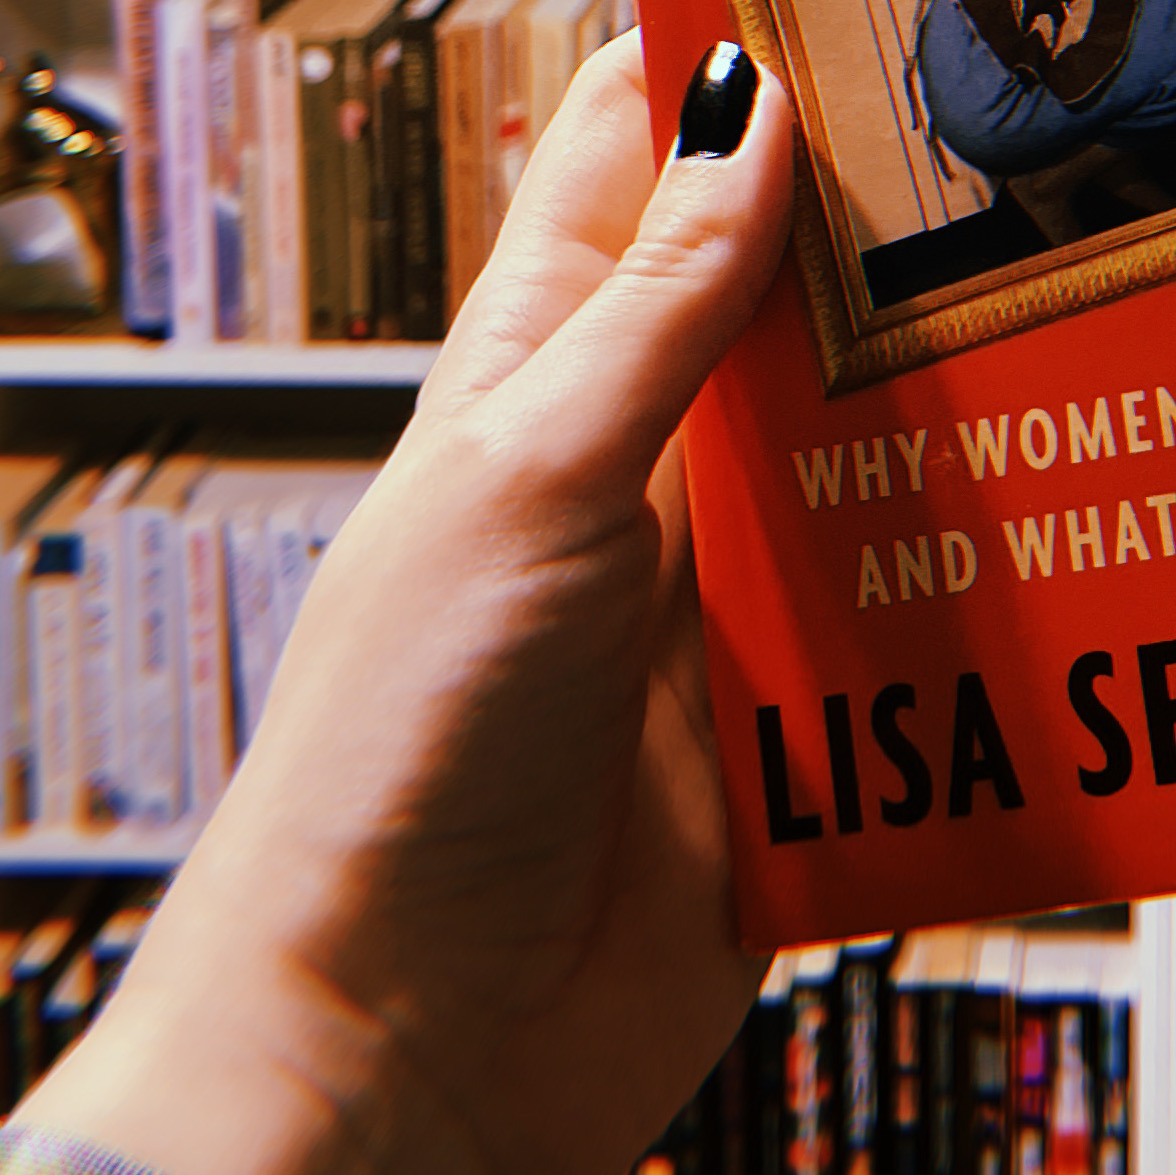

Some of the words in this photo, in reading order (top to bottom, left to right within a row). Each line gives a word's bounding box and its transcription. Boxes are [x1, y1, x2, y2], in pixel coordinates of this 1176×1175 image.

[792, 430, 930, 510] WHY
[856, 530, 978, 608] AND
[1003, 493, 1176, 580] WHAT
[756, 672, 1024, 845] LISA
